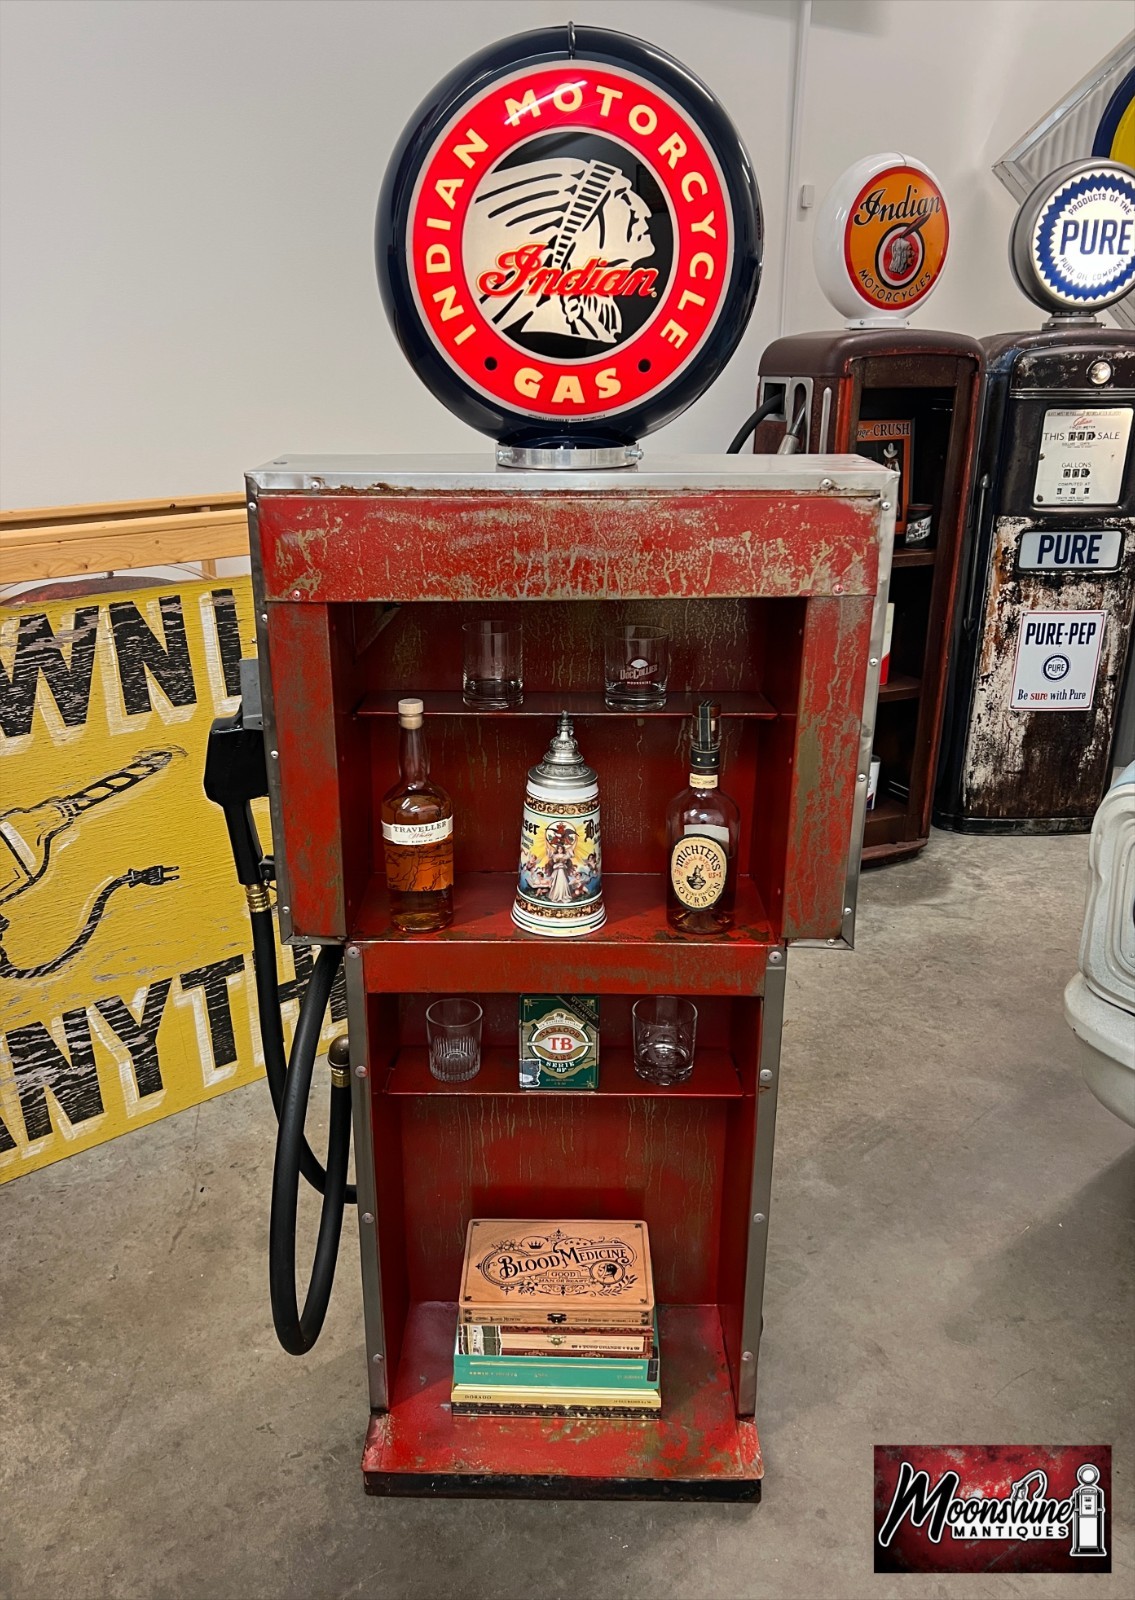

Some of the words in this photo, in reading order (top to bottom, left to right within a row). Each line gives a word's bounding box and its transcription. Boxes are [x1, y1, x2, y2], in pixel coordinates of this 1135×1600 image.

[426, 128, 489, 346] INDIAN
[504, 82, 717, 349] MOTORCYCLE
[853, 185, 943, 226] Indian
[1068, 193, 1106, 215] PRODUCTS
[1109, 194, 1119, 202] OF
[1119, 200, 1132, 215] THE
[1059, 219, 1134, 255] PURE
[478, 242, 660, 298] Indian
[1060, 257, 1076, 276] PURE
[1092, 258, 1125, 281] COMPANY
[858, 270, 931, 302] MOTORCYCLES
[514, 367, 622, 403] GAS
[857, 422, 910, 438] nge-CRUSH
[1044, 432, 1065, 441] THIS
[1097, 432, 1120, 440] SALE
[1037, 534, 1103, 564] PURE
[1025, 622, 1096, 645] PURE-PEP
[1047, 663, 1066, 672] PURE
[1017, 689, 1029, 701] Be
[1030, 691, 1048, 701] sure
[1050, 689, 1067, 701] with
[1068, 689, 1086, 700] Pure
[393, 821, 447, 833] TRAVELLER
[676, 845, 721, 871] MICHTER'S
[675, 879, 721, 903] BOURBON
[548, 1037, 573, 1051] TB
[498, 1255, 560, 1280] BLOOD
[556, 1245, 628, 1269] MEDICINE
